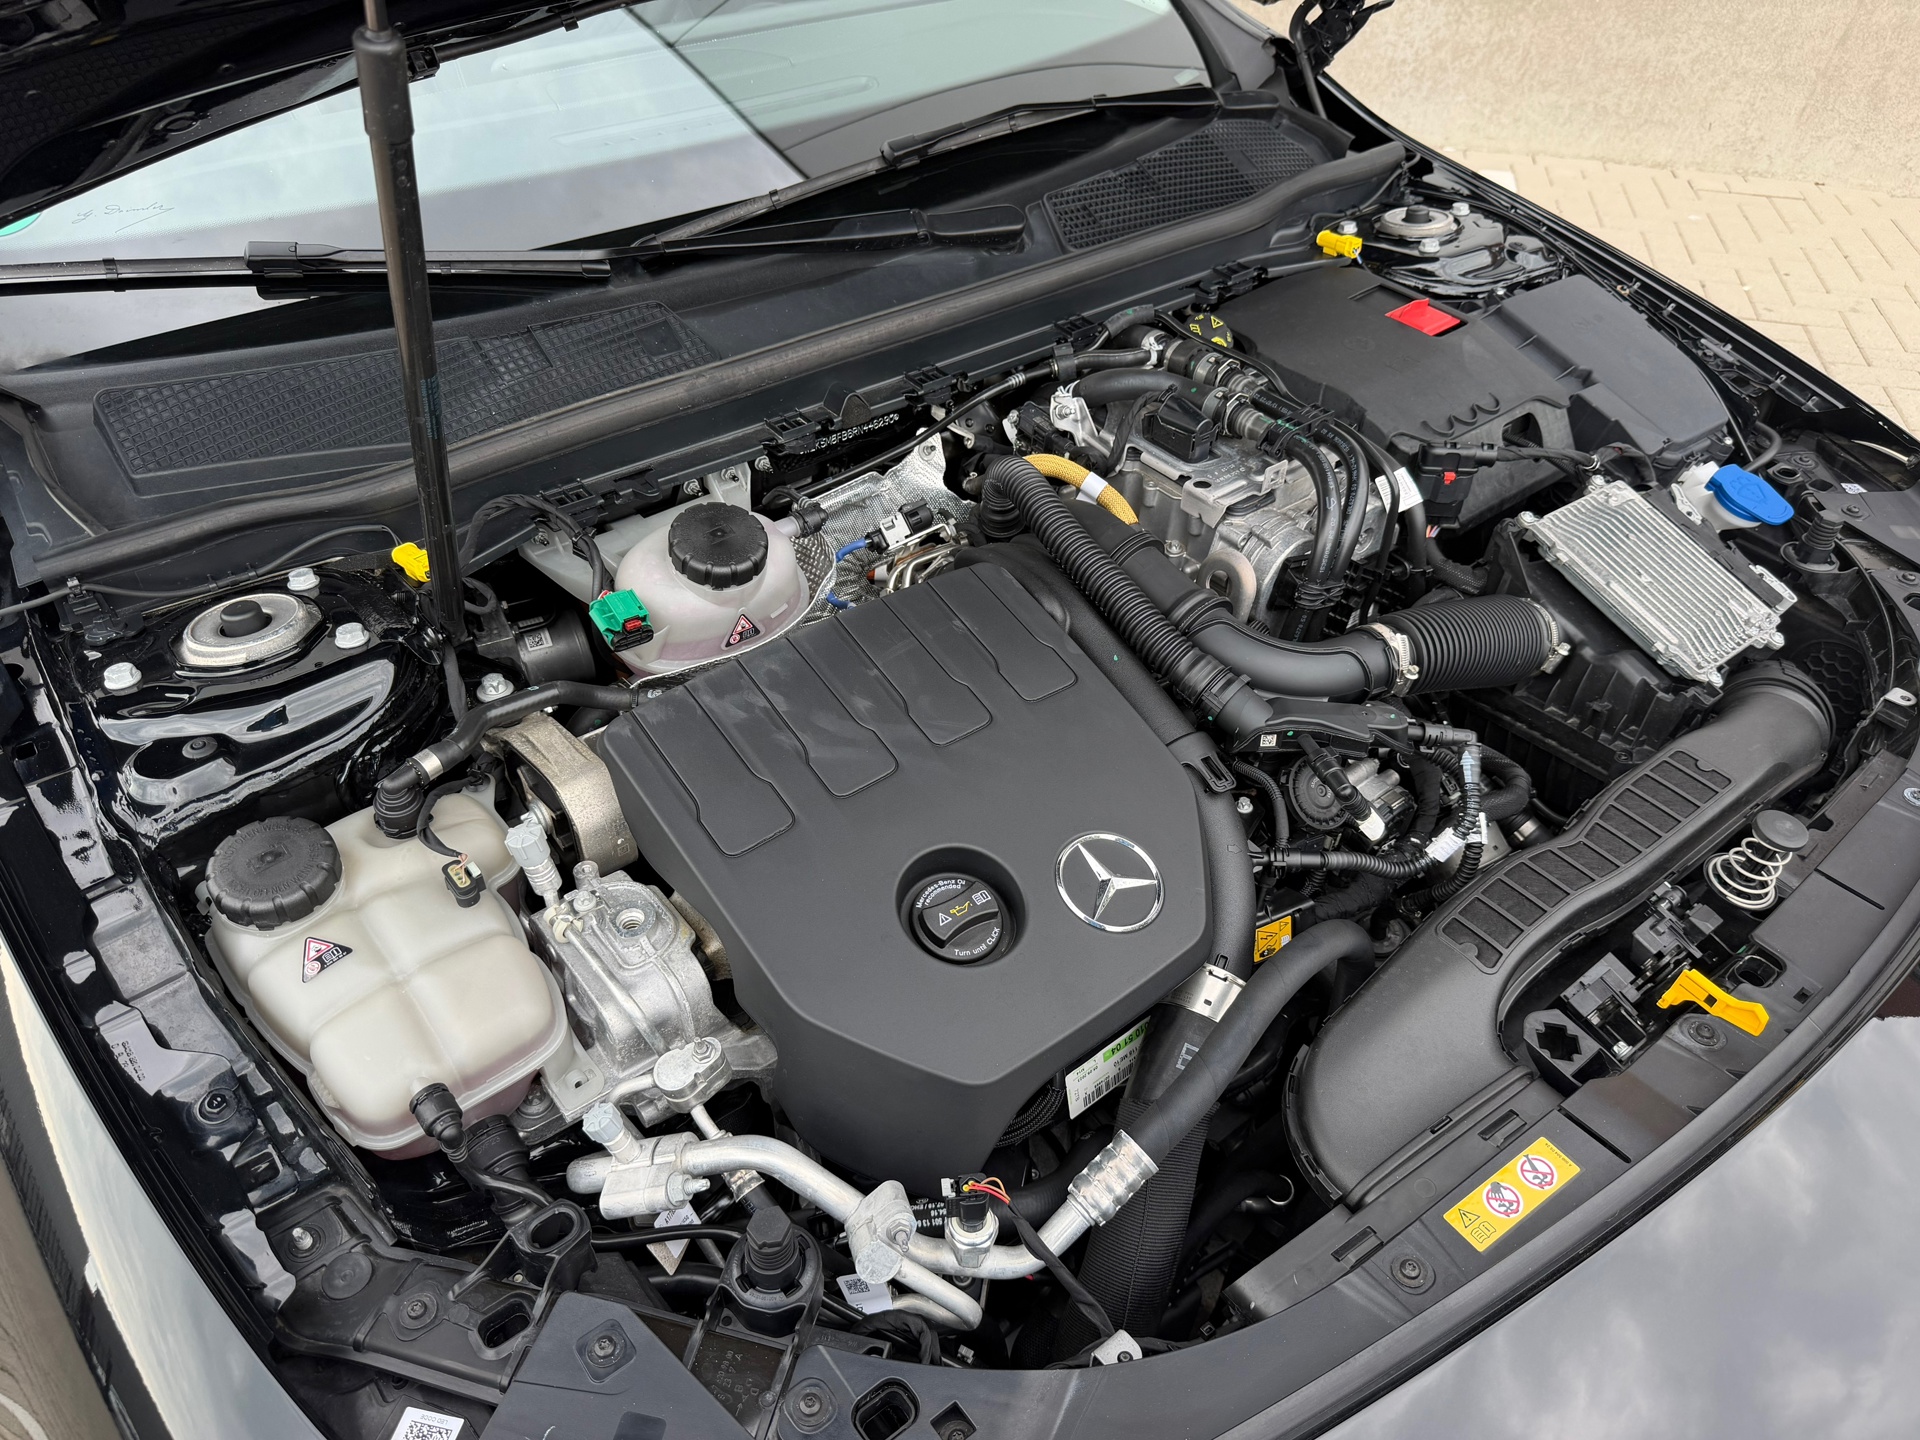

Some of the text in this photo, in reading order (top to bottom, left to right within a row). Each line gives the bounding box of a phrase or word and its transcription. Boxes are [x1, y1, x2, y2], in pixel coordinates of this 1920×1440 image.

[234, 828, 260, 845] OPEN
[915, 879, 956, 908] Mercedes-Benz
[924, 883, 962, 906] recommended
[954, 926, 1001, 956] Turn until CLICK
[1124, 1034, 1134, 1045] 51
[1111, 1043, 1122, 1056] 04
[922, 1219, 931, 1227] 13
[931, 1217, 943, 1227] 501
[420, 1413, 436, 1423] CODE
